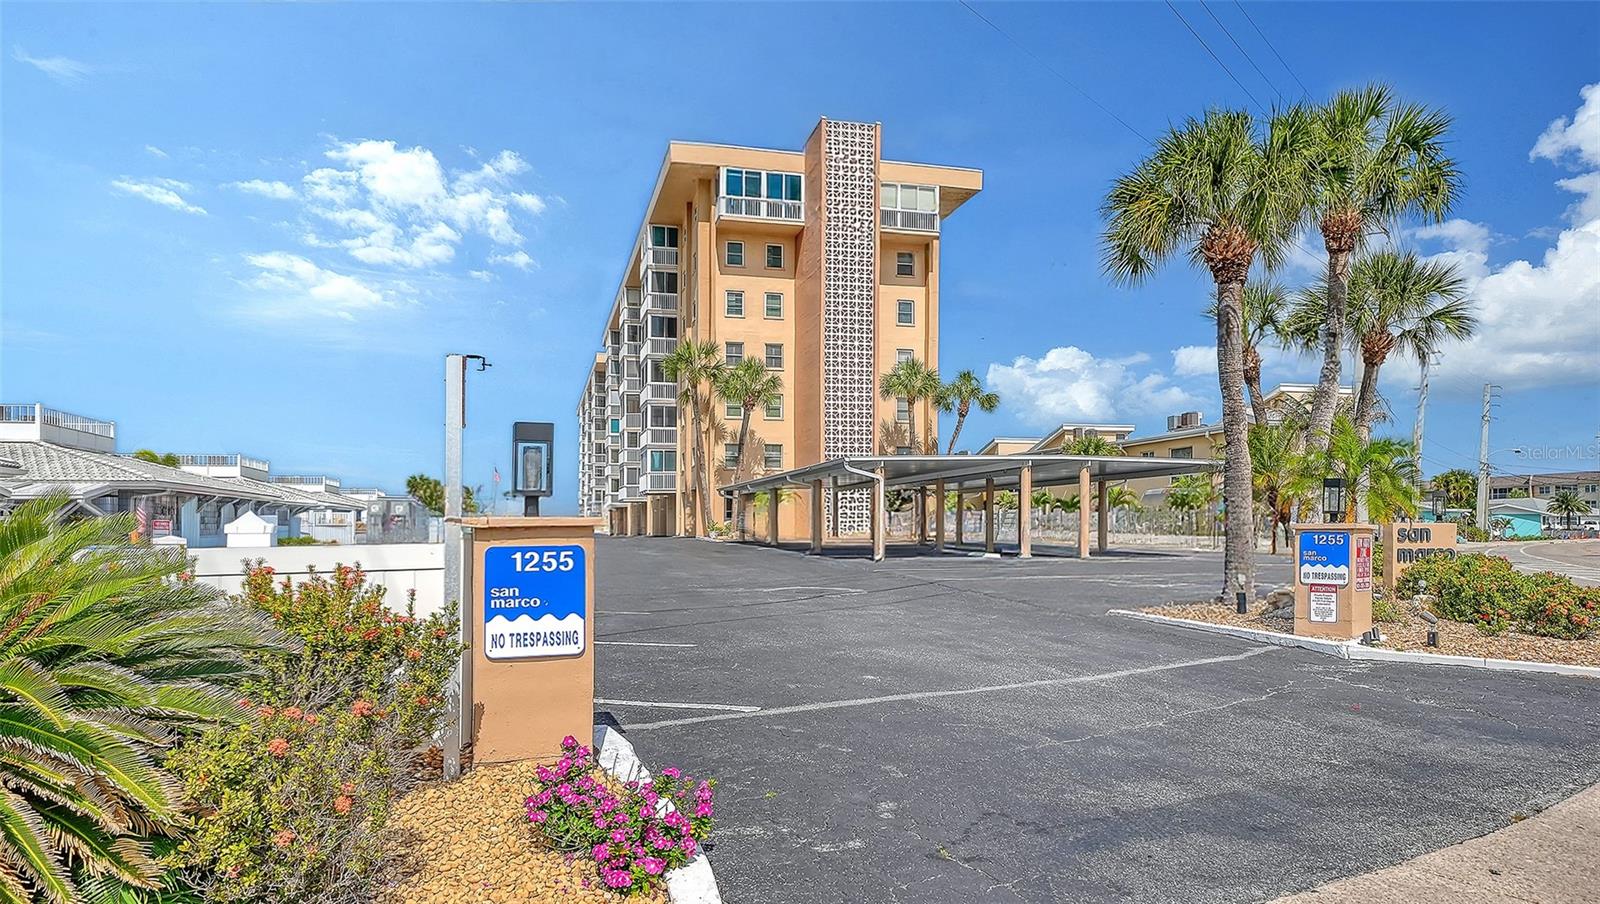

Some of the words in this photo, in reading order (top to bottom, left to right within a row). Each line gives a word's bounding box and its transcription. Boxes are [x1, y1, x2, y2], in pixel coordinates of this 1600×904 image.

[1312, 534, 1344, 546] 1255
[1397, 527, 1432, 543] san
[511, 550, 574, 572] 1255
[1302, 572, 1311, 580] NO
[1311, 572, 1347, 581] TRESPASSING
[490, 587, 519, 597] san
[490, 597, 541, 608] marco
[491, 633, 506, 649] NO
[509, 630, 579, 648] TRESPASSING
